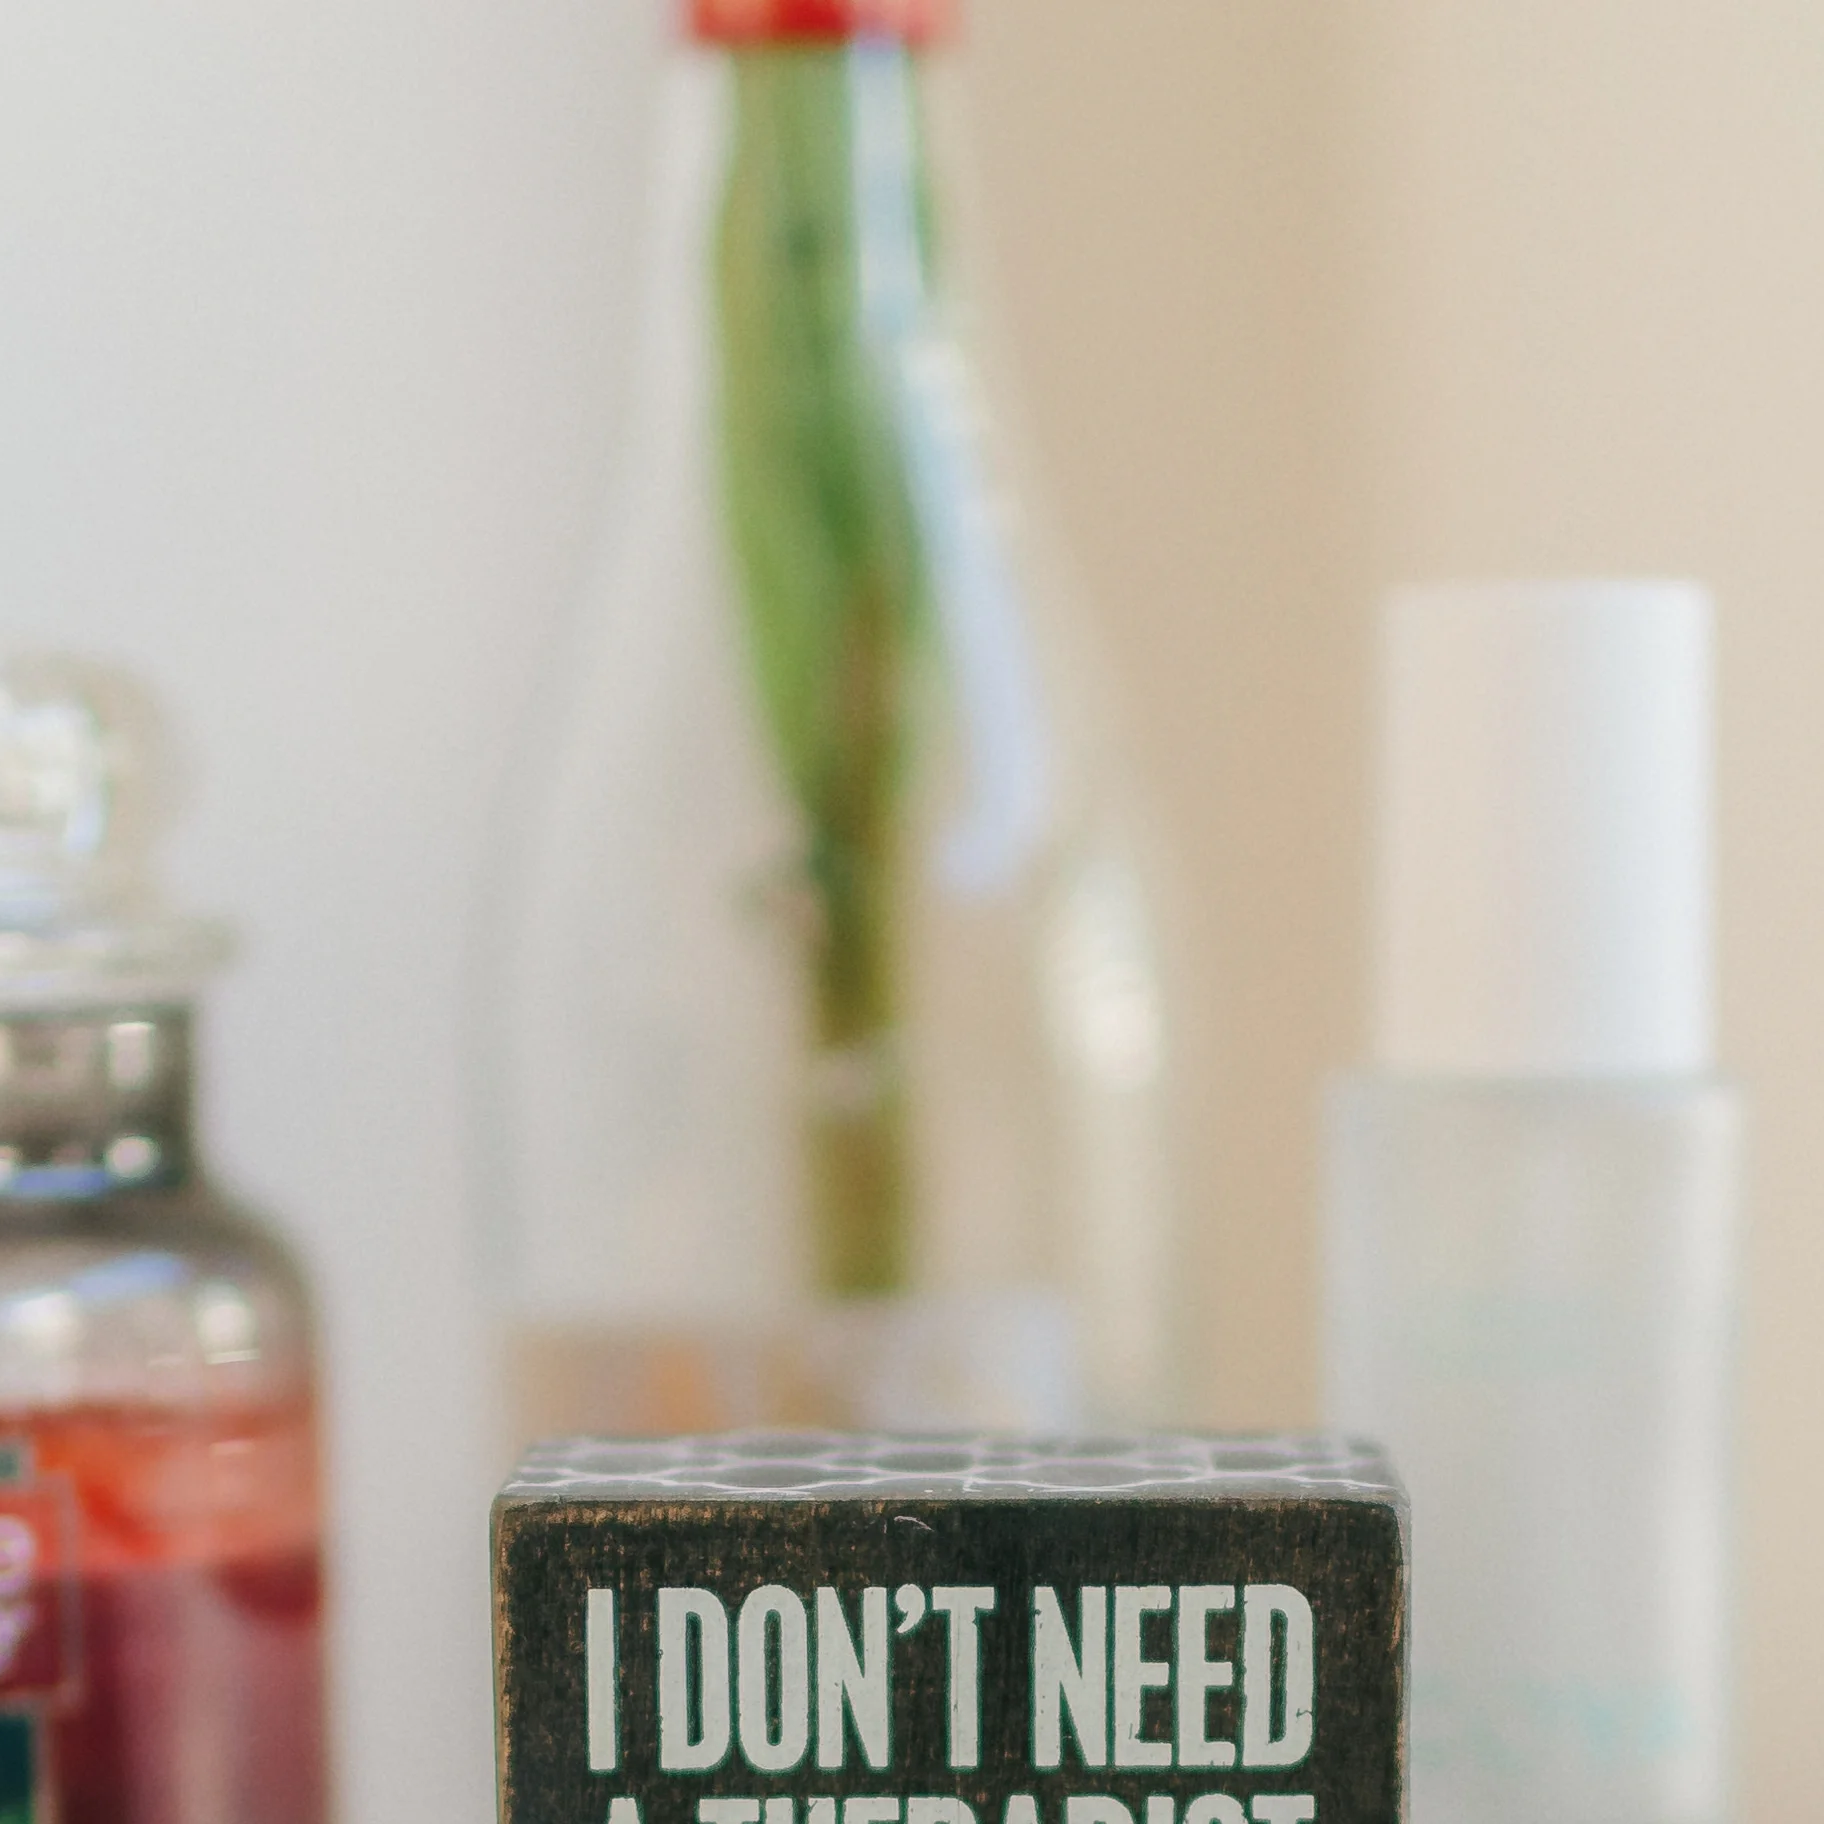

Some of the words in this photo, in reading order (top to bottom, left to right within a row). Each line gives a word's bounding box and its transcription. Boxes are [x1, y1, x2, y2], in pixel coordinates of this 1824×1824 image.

[587, 1588, 614, 1770] I
[658, 1585, 994, 1772] DON'T
[1033, 1584, 1314, 1770] NEED
